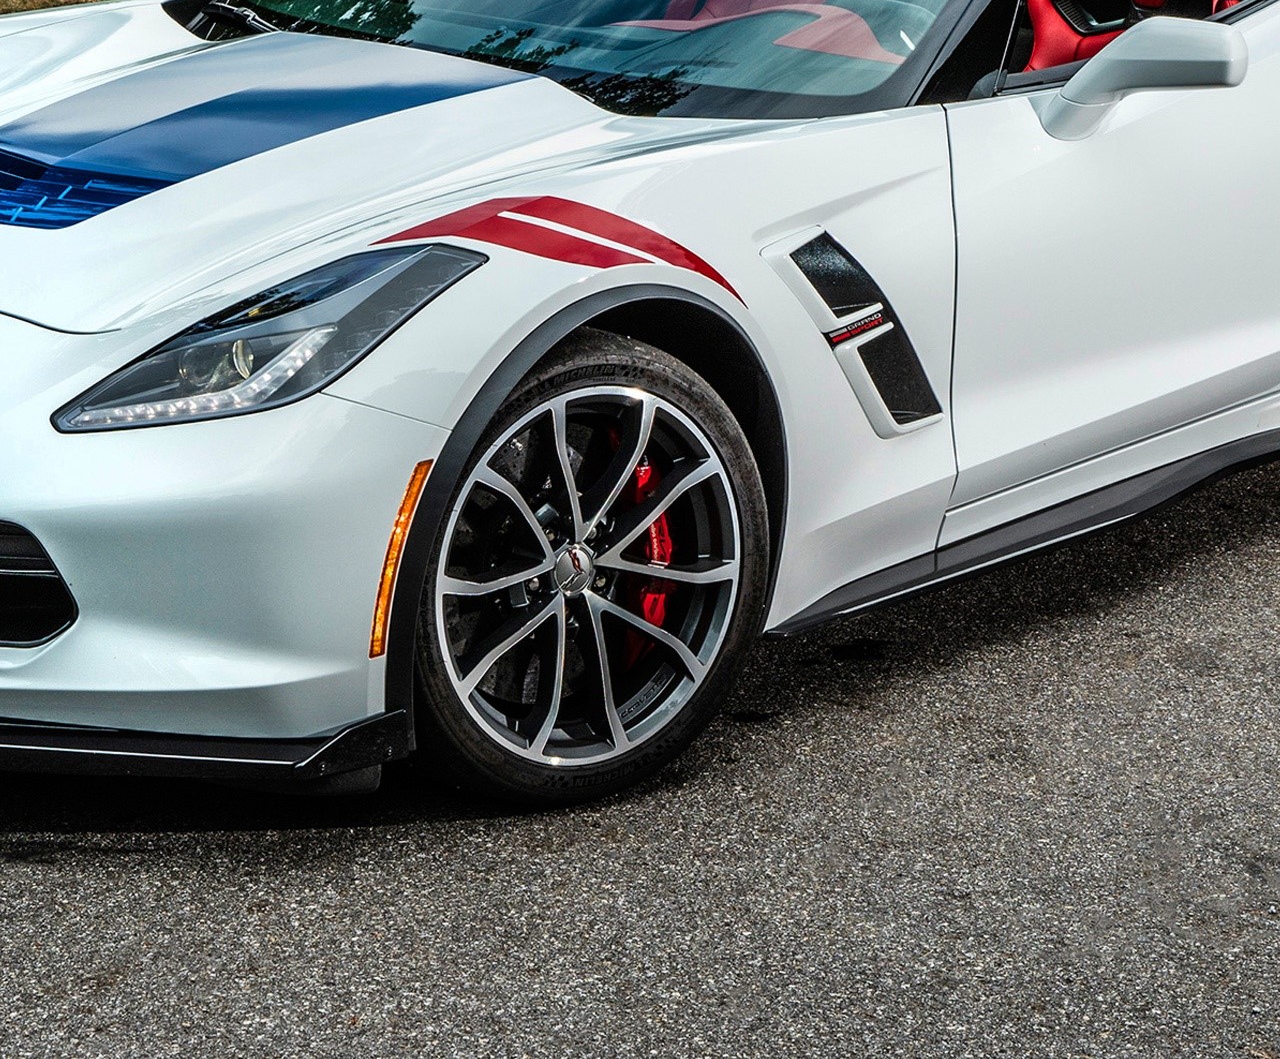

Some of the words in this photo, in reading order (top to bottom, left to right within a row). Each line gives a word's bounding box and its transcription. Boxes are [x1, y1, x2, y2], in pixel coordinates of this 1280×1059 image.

[847, 312, 882, 330] GRAND
[851, 317, 883, 335] SPORT
[552, 364, 617, 388] MICHELIN
